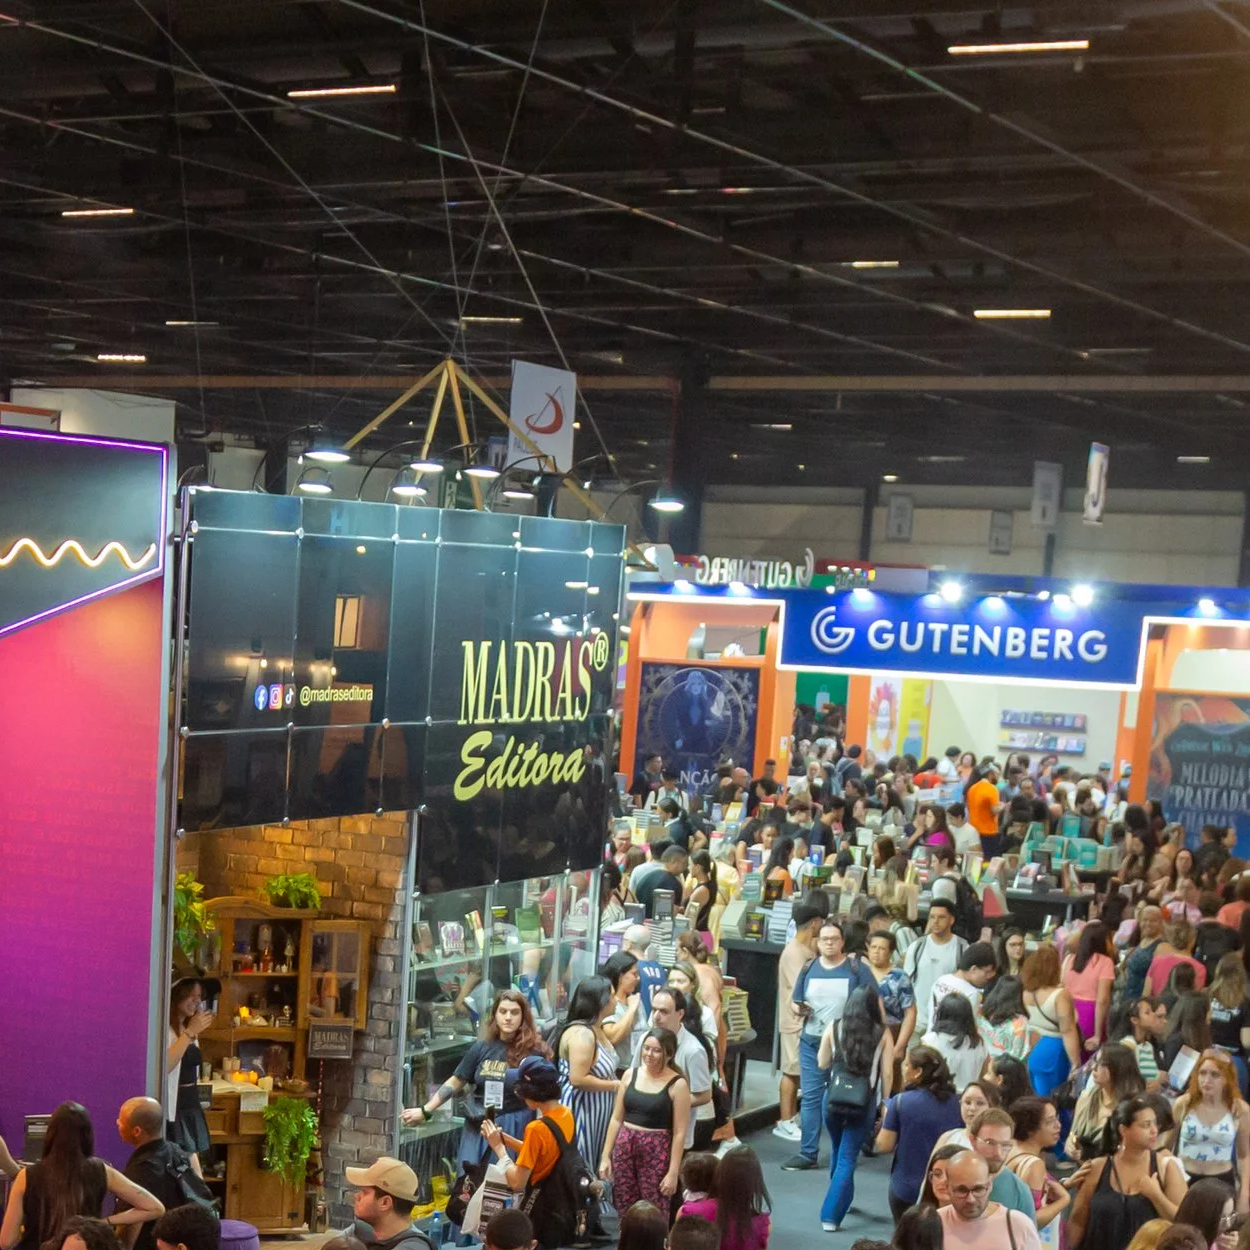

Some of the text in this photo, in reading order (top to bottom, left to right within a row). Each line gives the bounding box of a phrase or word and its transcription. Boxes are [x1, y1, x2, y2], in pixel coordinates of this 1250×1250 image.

[867, 619, 1108, 663] GUTENBERG
[300, 685, 373, 706] @madraseditora
[453, 730, 586, 801] Editora
